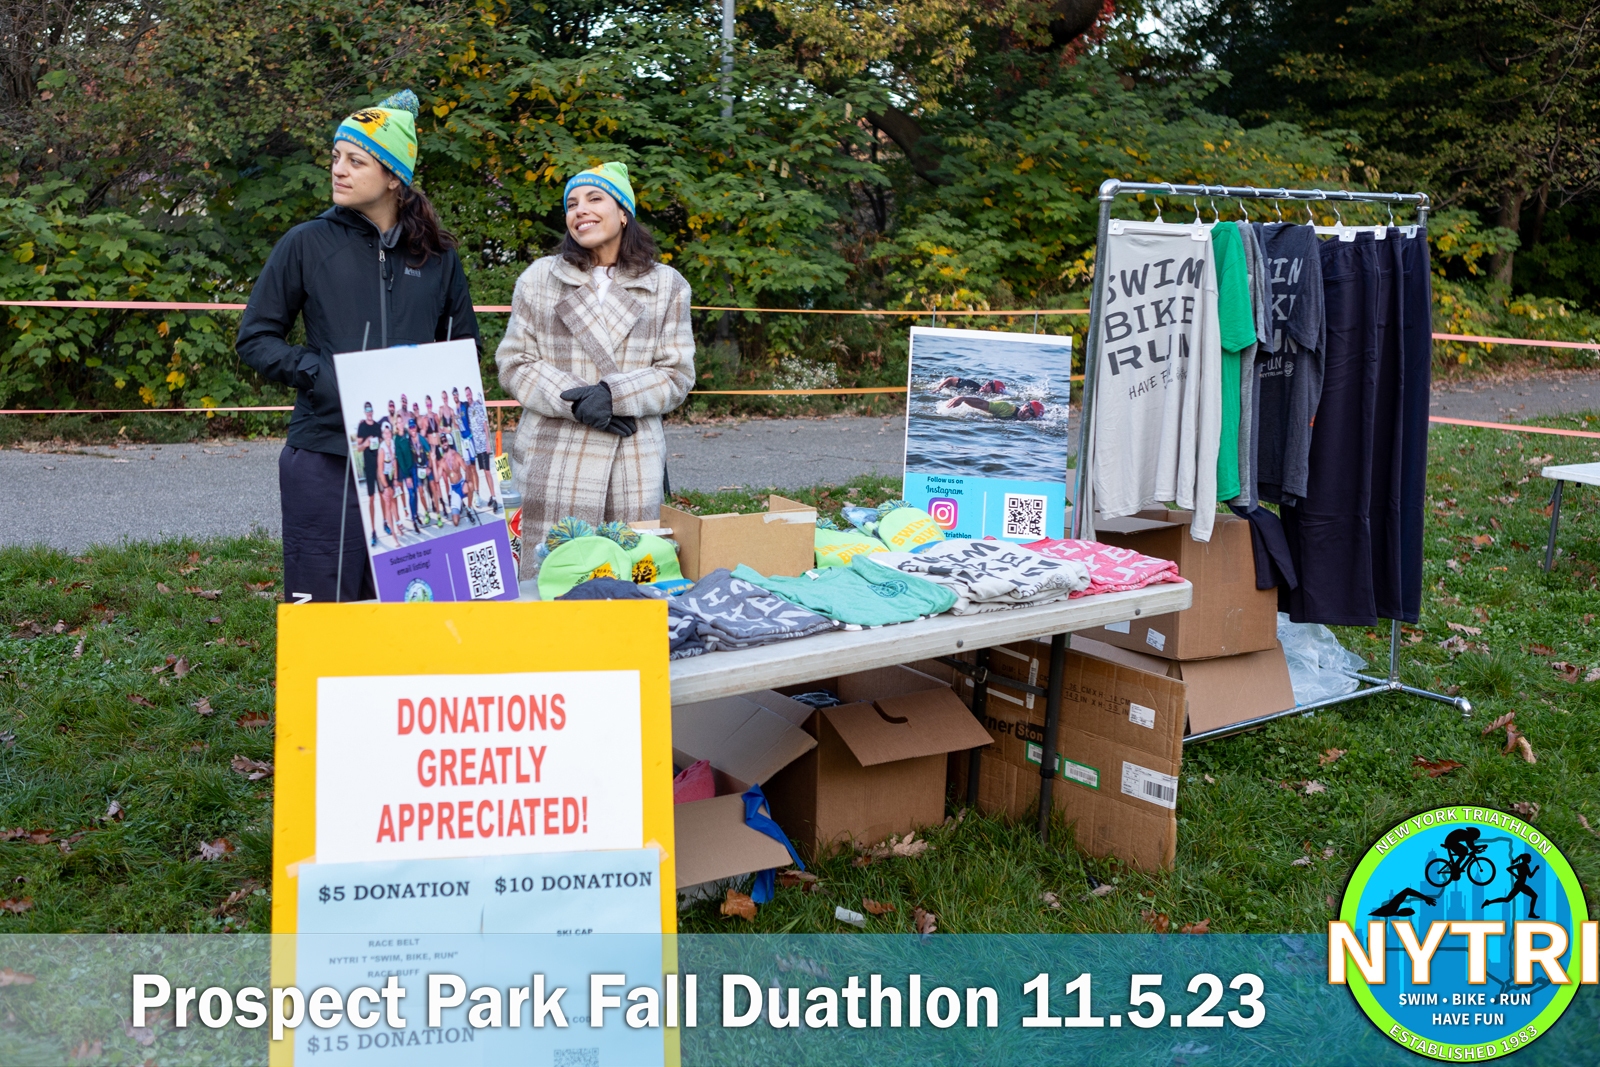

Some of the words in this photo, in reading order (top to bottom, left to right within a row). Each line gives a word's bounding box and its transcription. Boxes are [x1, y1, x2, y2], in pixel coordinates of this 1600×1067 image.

[1107, 257, 1205, 305] SWIM
[1105, 296, 1195, 344] BIKE
[1129, 375, 1157, 400] HAVE
[927, 476, 947, 484] Follow
[925, 484, 964, 498] Instagram
[943, 531, 972, 540] triathlon
[390, 553, 416, 566] Subscribe
[397, 565, 412, 576] email
[397, 693, 567, 736] DONATIONS
[1017, 724, 1044, 743] Ston
[417, 745, 547, 788] GREATLY
[376, 796, 588, 843] APPRECIATED!
[494, 876, 534, 895] $10
[541, 871, 653, 892] DONATION
[318, 884, 346, 903] $5
[354, 881, 471, 901] DONATION
[556, 929, 573, 938] SKI
[574, 927, 593, 937] CAP
[368, 939, 394, 948] RACE
[396, 938, 420, 947] BELT
[329, 957, 359, 965] NYTRI
[406, 953, 432, 962] BIKE,
[367, 970, 393, 979] RACE
[396, 969, 420, 978] BUFF
[572, 1016, 591, 1024] COD
[307, 1035, 349, 1055] $15
[357, 1027, 476, 1050] DONATION
